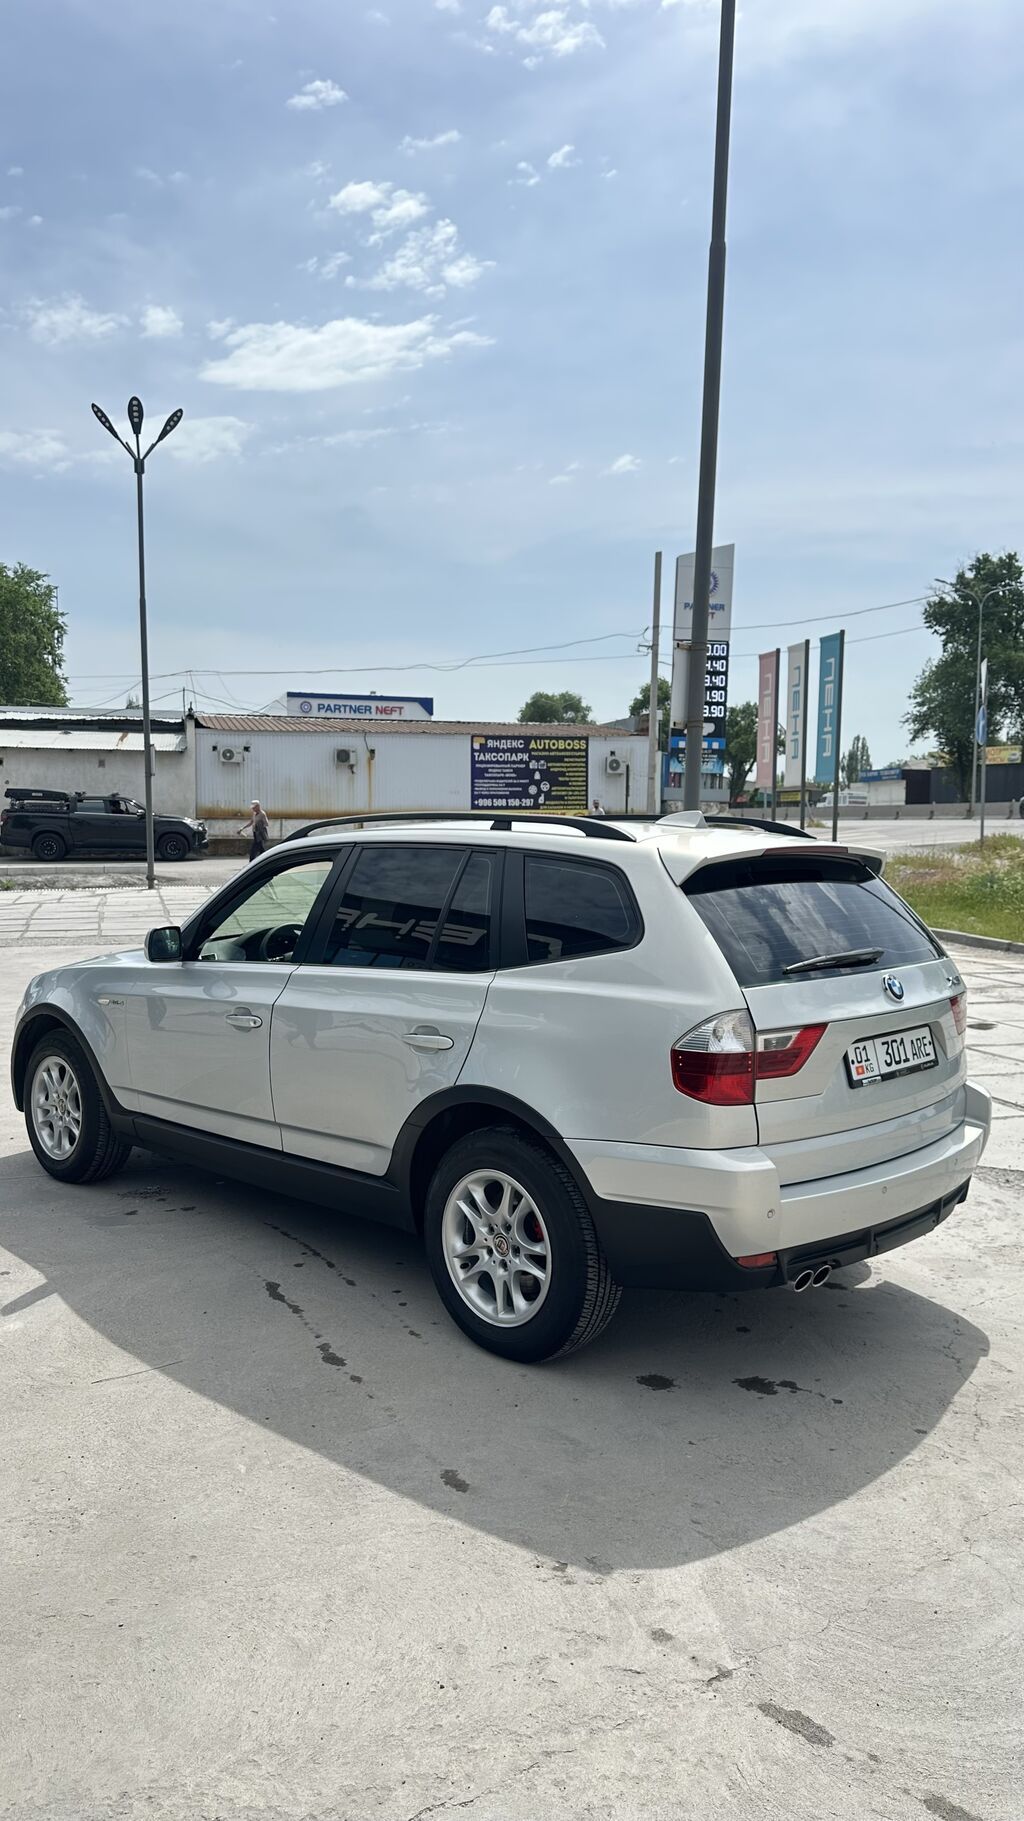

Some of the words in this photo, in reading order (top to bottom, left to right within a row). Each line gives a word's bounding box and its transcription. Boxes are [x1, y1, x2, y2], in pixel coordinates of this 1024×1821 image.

[684, 602, 725, 612] PANER
[705, 660, 726, 671] 4.40
[706, 690, 725, 702] 1.90
[317, 703, 372, 715] PARTNER
[375, 705, 404, 716] NEFT
[487, 739, 525, 749] ЯНДЕКС
[529, 739, 587, 750] AUTOBOSS
[473, 752, 529, 762] ТАКСОПАРК
[473, 798, 493, 807] +996
[854, 1045, 871, 1064] 01
[881, 1037, 910, 1067] 301
[910, 1036, 931, 1061] ARE
[865, 1062, 875, 1073] KG
